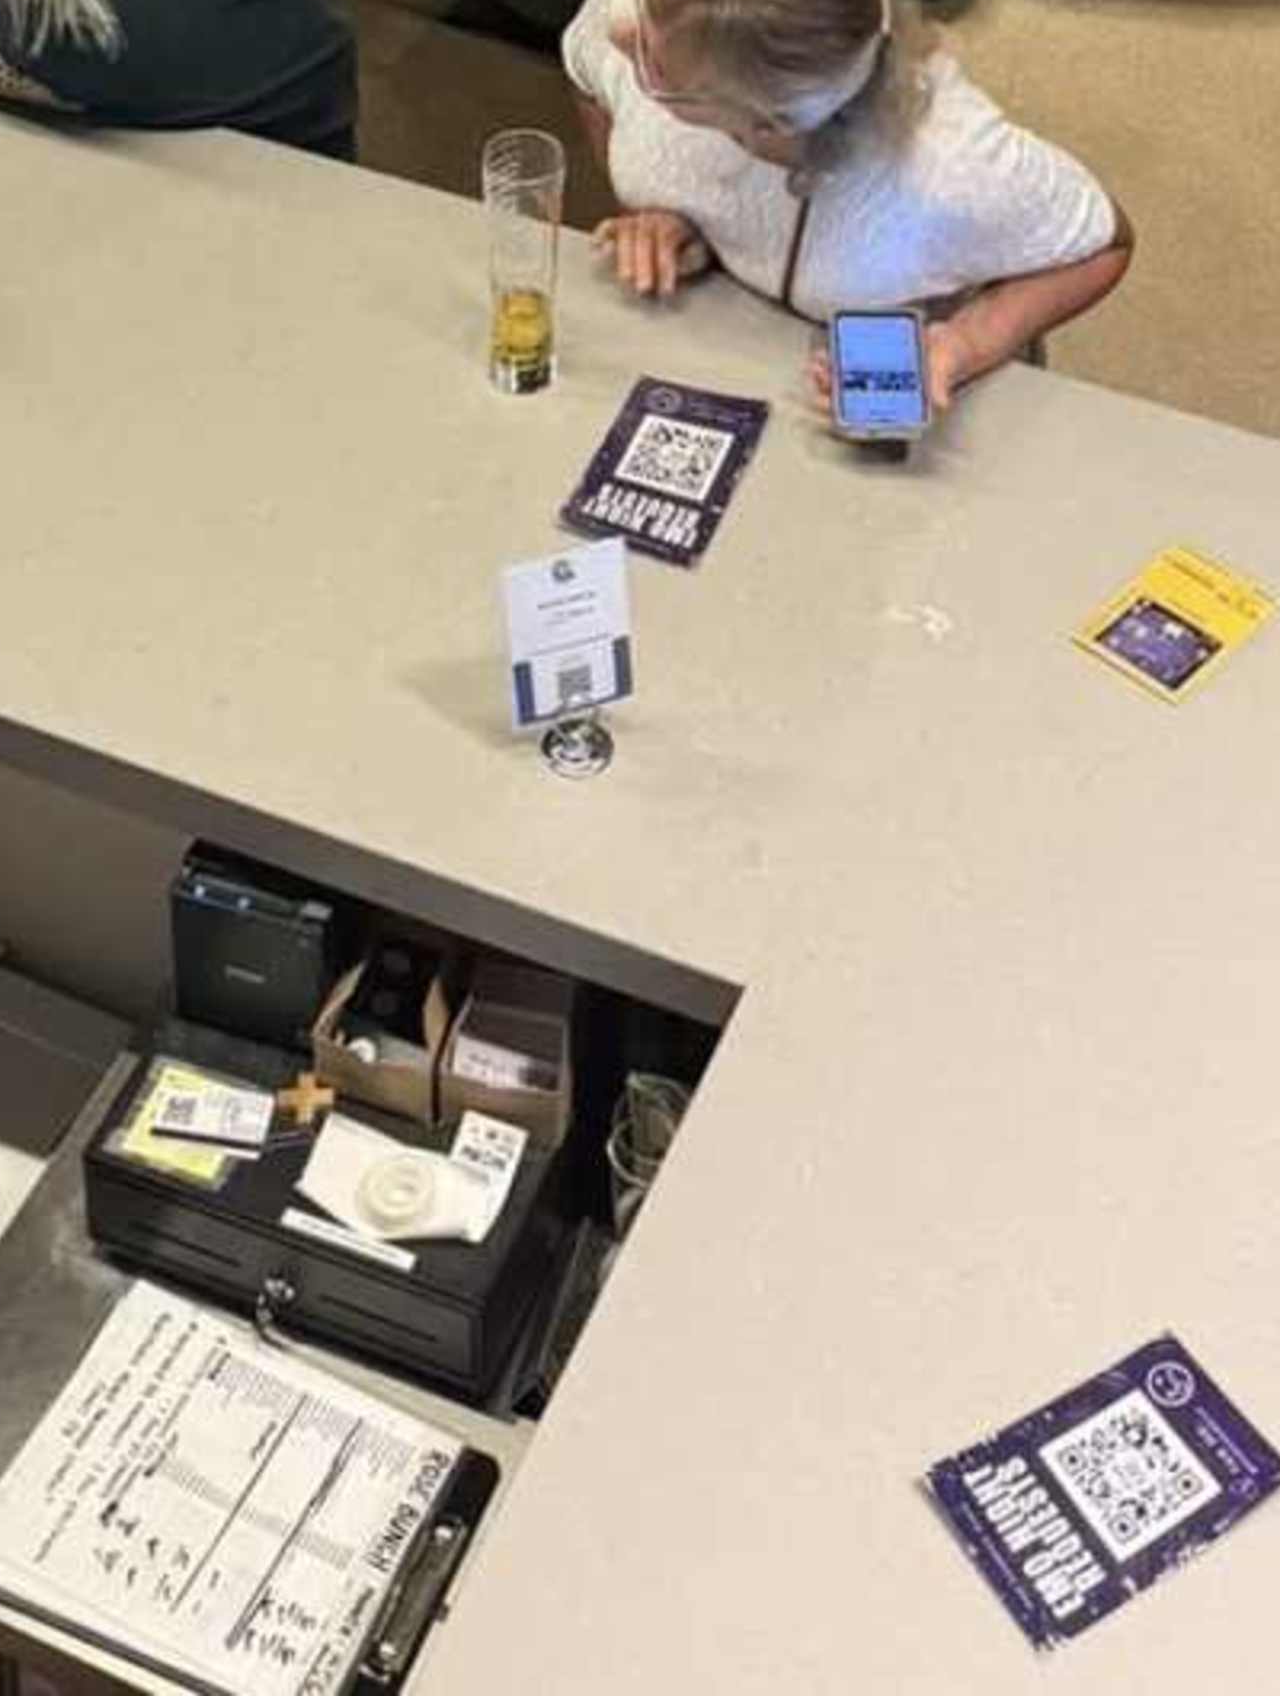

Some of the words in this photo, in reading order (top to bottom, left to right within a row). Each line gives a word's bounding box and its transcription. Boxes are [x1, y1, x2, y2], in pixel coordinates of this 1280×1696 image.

[962, 1464, 1040, 1554] NIGHT
[998, 1456, 1107, 1592] REQUESTS
[1022, 1549, 1088, 1620] EMO
